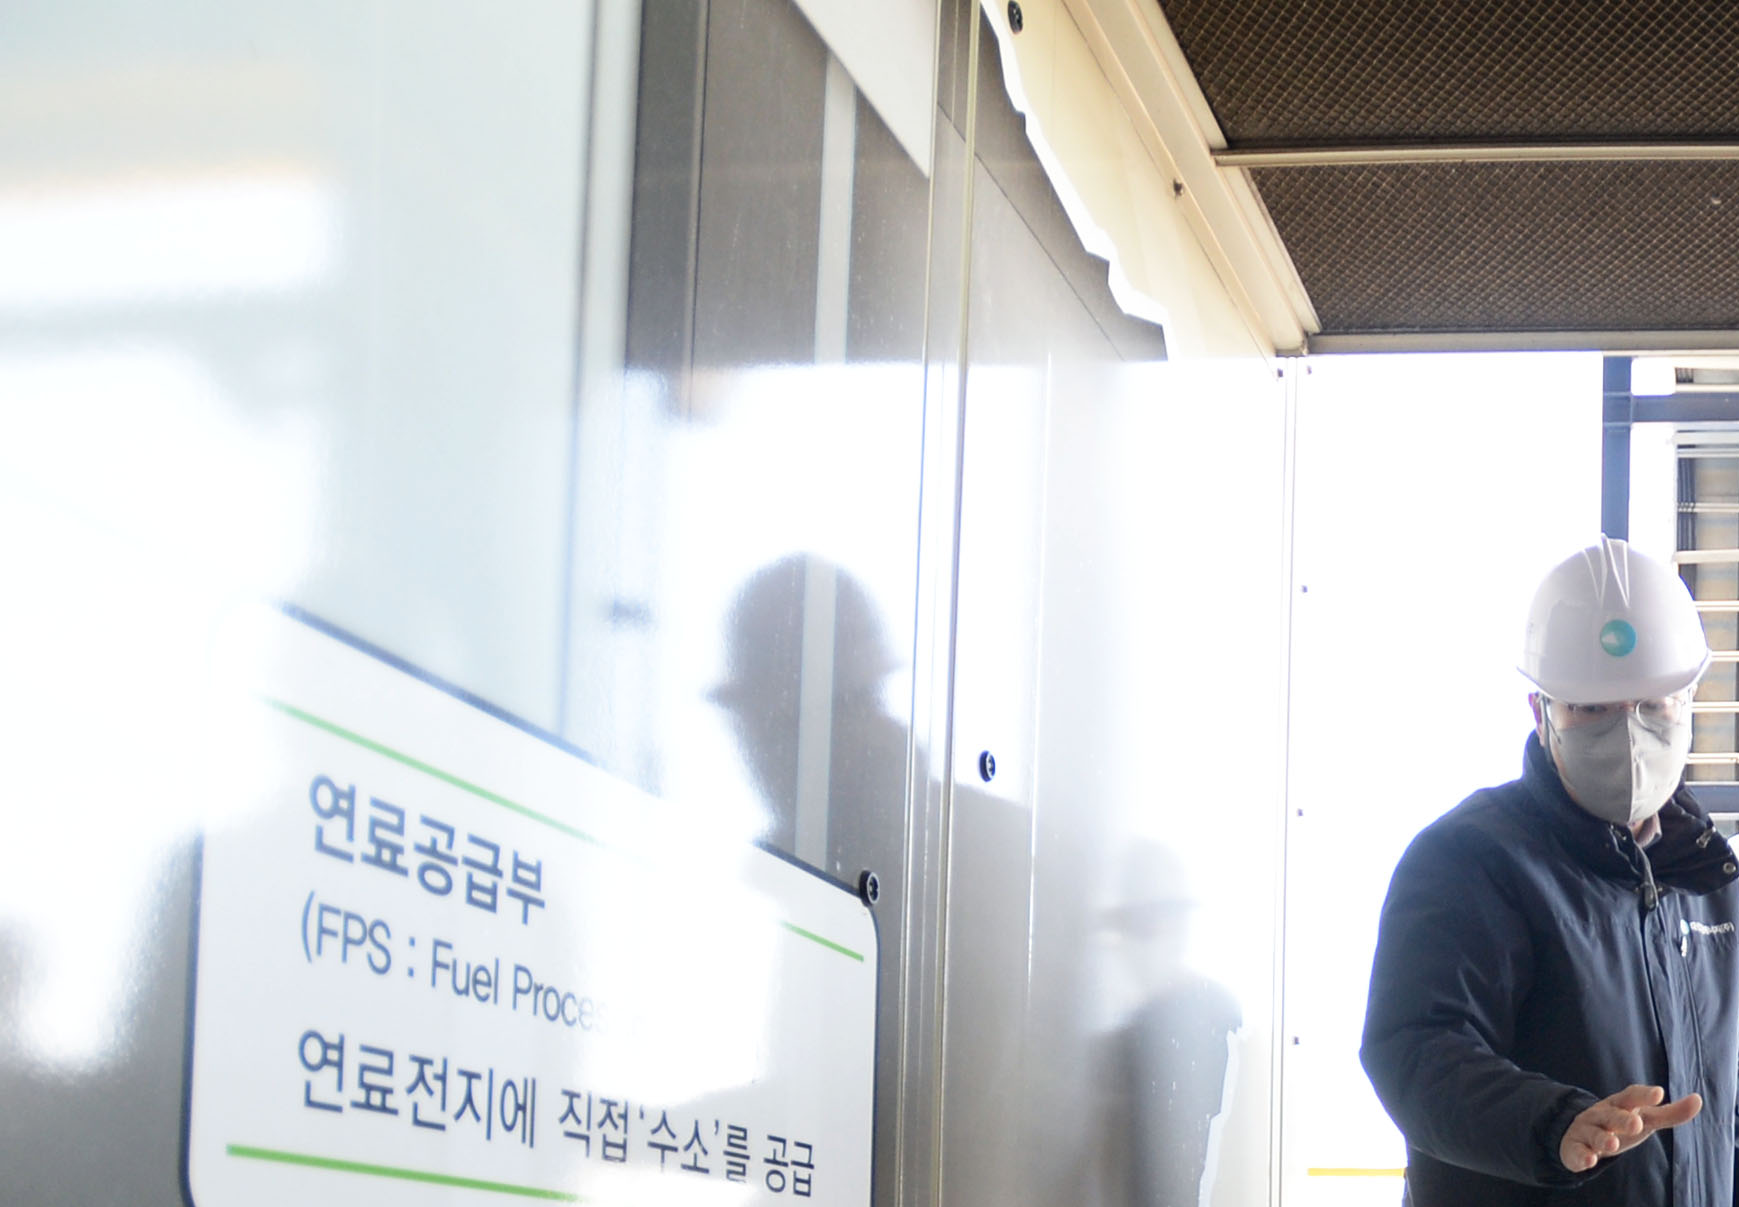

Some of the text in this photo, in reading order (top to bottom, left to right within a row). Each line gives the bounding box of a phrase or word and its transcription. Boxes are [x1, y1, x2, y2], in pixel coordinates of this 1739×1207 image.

[309, 774, 546, 926] 연료공급부
[301, 890, 392, 976] (FPS
[431, 938, 500, 1006] Fuel
[298, 1029, 537, 1149] 연료전지에
[558, 1088, 630, 1163] 직접
[763, 1133, 815, 1198] 공급
